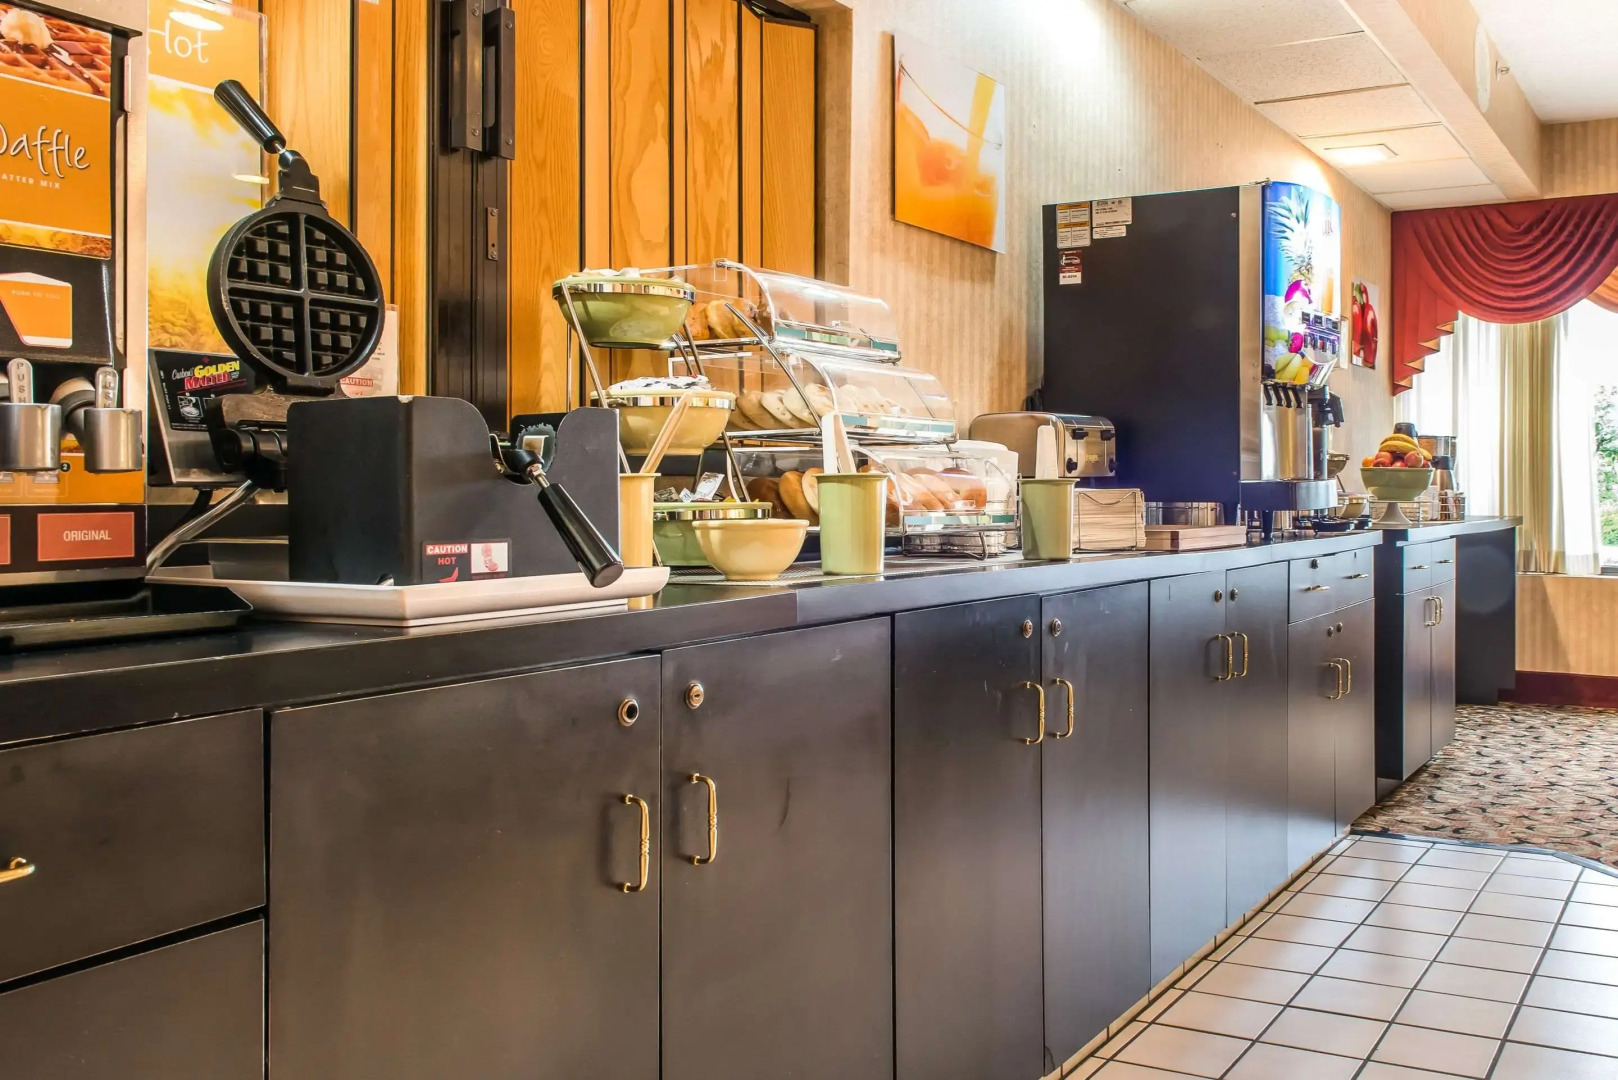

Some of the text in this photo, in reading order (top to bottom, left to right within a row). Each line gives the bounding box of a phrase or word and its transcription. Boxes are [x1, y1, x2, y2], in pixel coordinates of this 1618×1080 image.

[1, 173, 35, 185] ATTER
[194, 360, 240, 377] GOLDEN
[184, 372, 230, 390] MALTED
[340, 377, 373, 386] CAUTION
[63, 530, 112, 541] ORIGINAL
[427, 544, 468, 554] CAUTION
[437, 557, 457, 565] HOT
